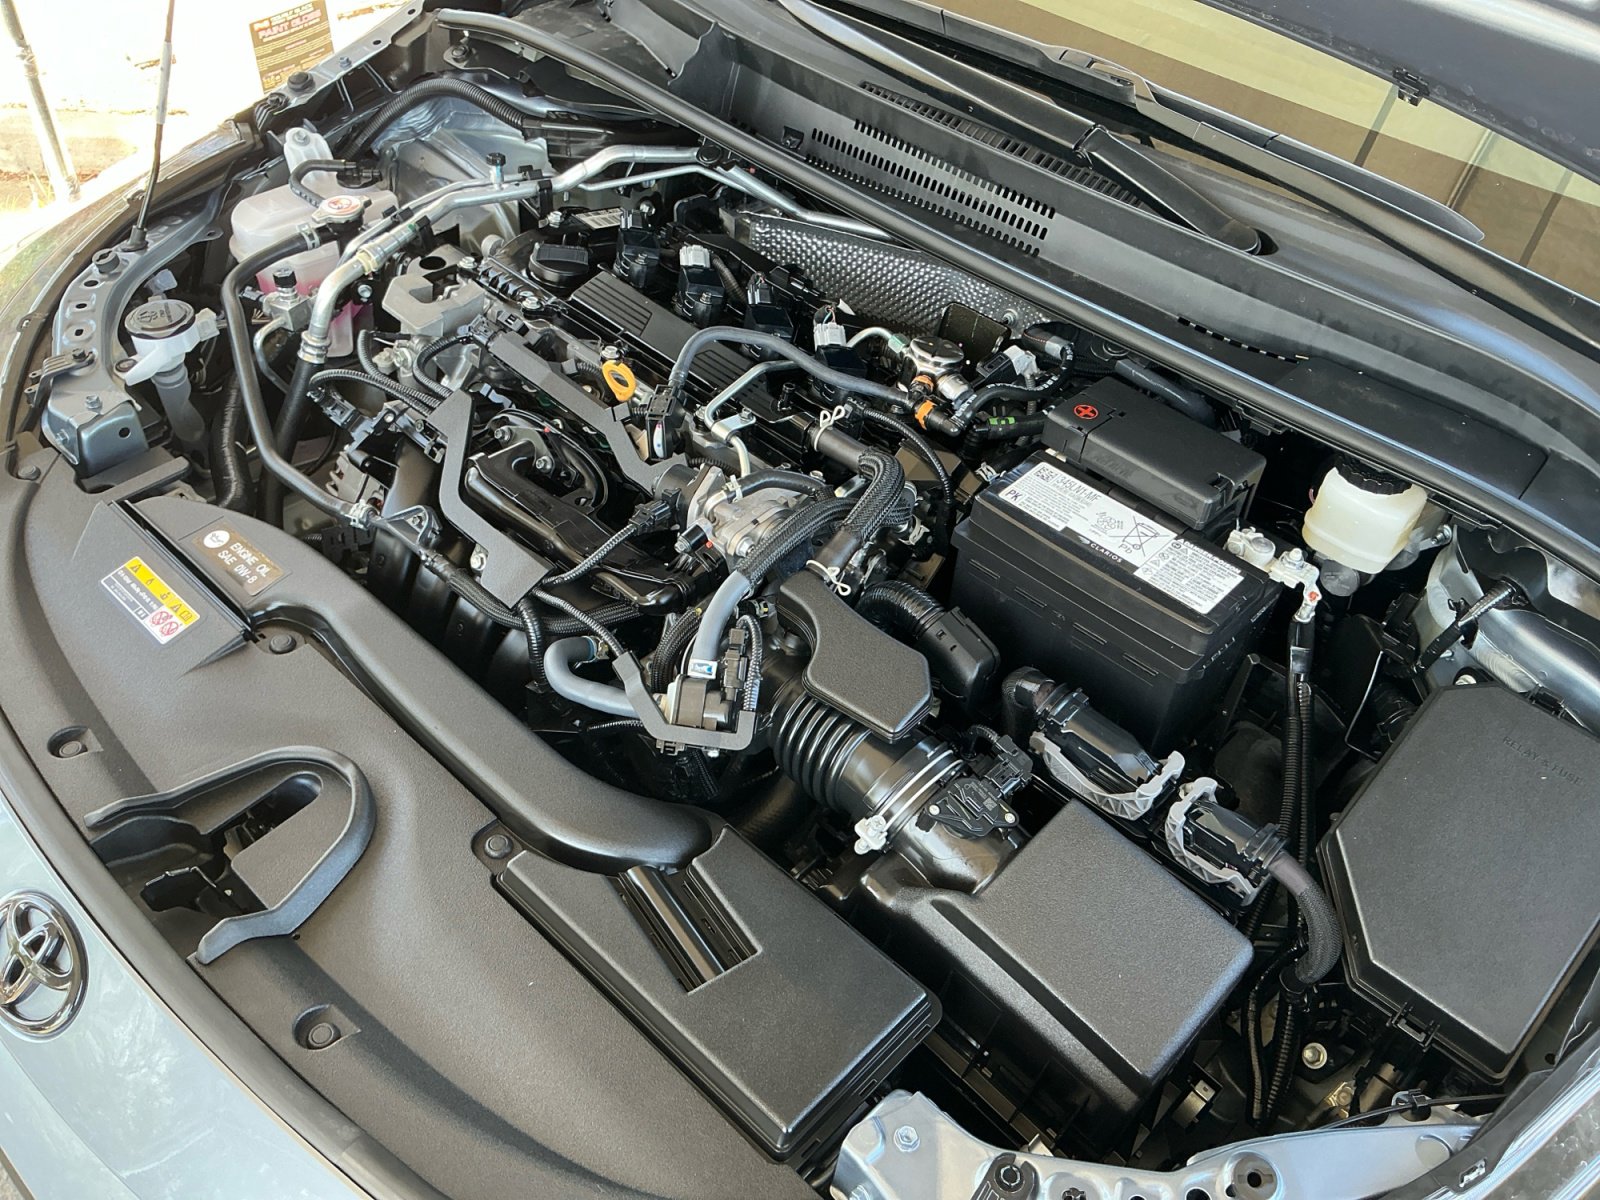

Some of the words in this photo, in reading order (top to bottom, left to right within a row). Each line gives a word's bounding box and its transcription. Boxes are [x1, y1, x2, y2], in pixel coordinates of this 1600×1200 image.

[1005, 489, 1021, 501] PK
[217, 550, 237, 565] SAE
[230, 542, 259, 566] ENGINE
[256, 564, 271, 578] OIL
[1090, 543, 1122, 563] CLARIOS
[1502, 736, 1540, 760] RELAY
[1551, 764, 1584, 785] FUSE
